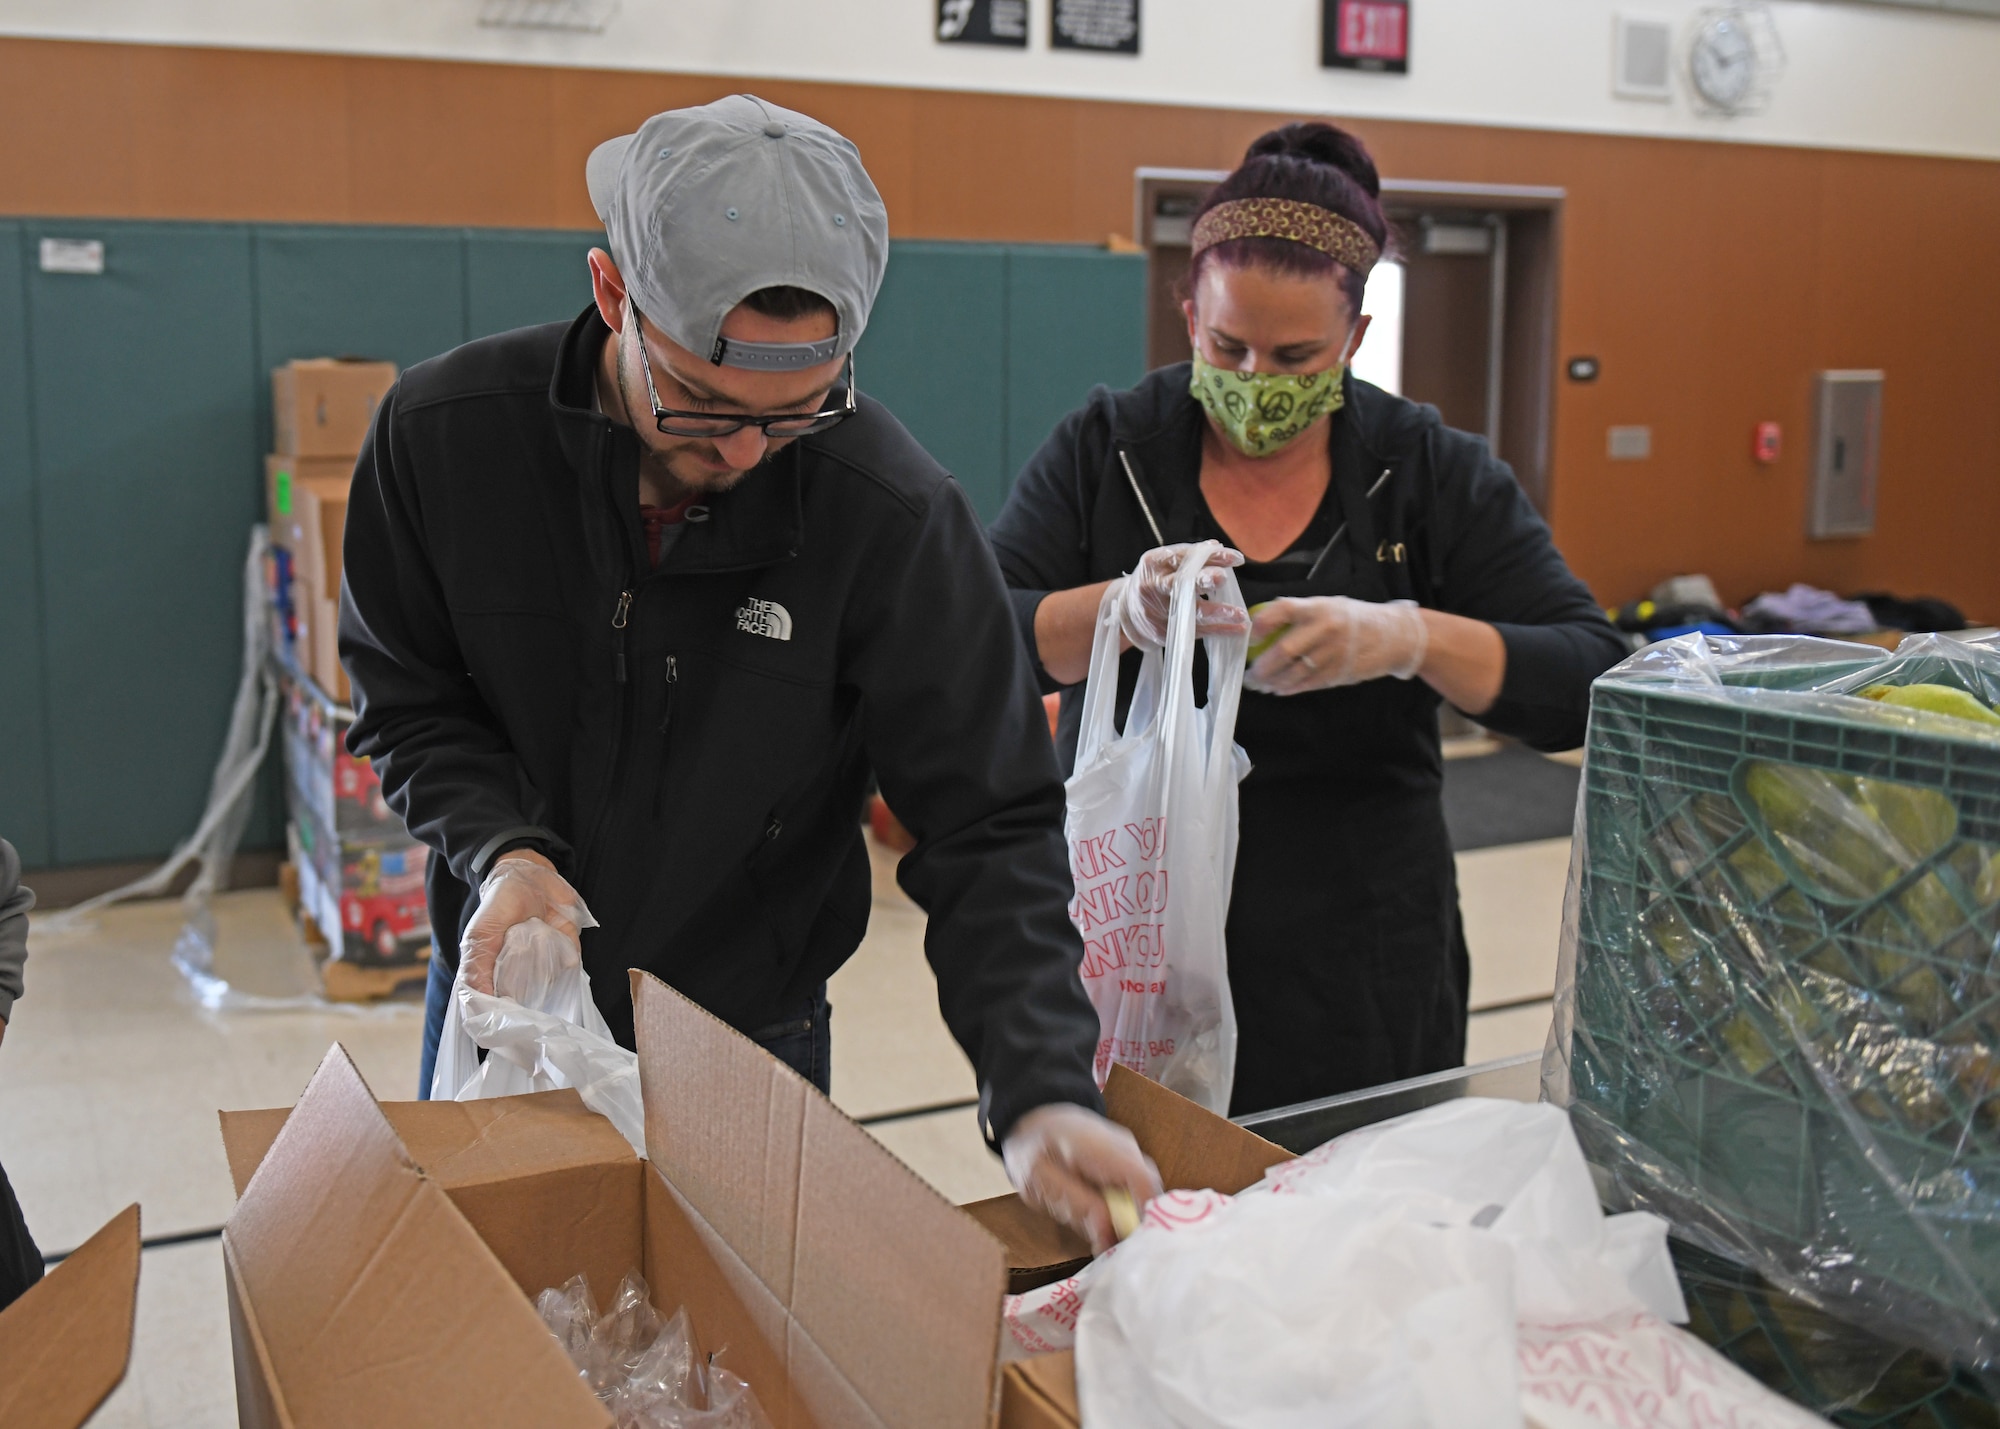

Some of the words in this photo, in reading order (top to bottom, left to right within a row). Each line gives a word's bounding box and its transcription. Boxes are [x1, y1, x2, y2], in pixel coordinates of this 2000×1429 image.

[1344, 1, 1403, 53] EXIT
[748, 597, 772, 612] THE
[737, 619, 767, 636] FACE
[1072, 829, 1127, 880] NK
[1069, 875, 1135, 932] NK
[1148, 1038, 1175, 1057] BAG
